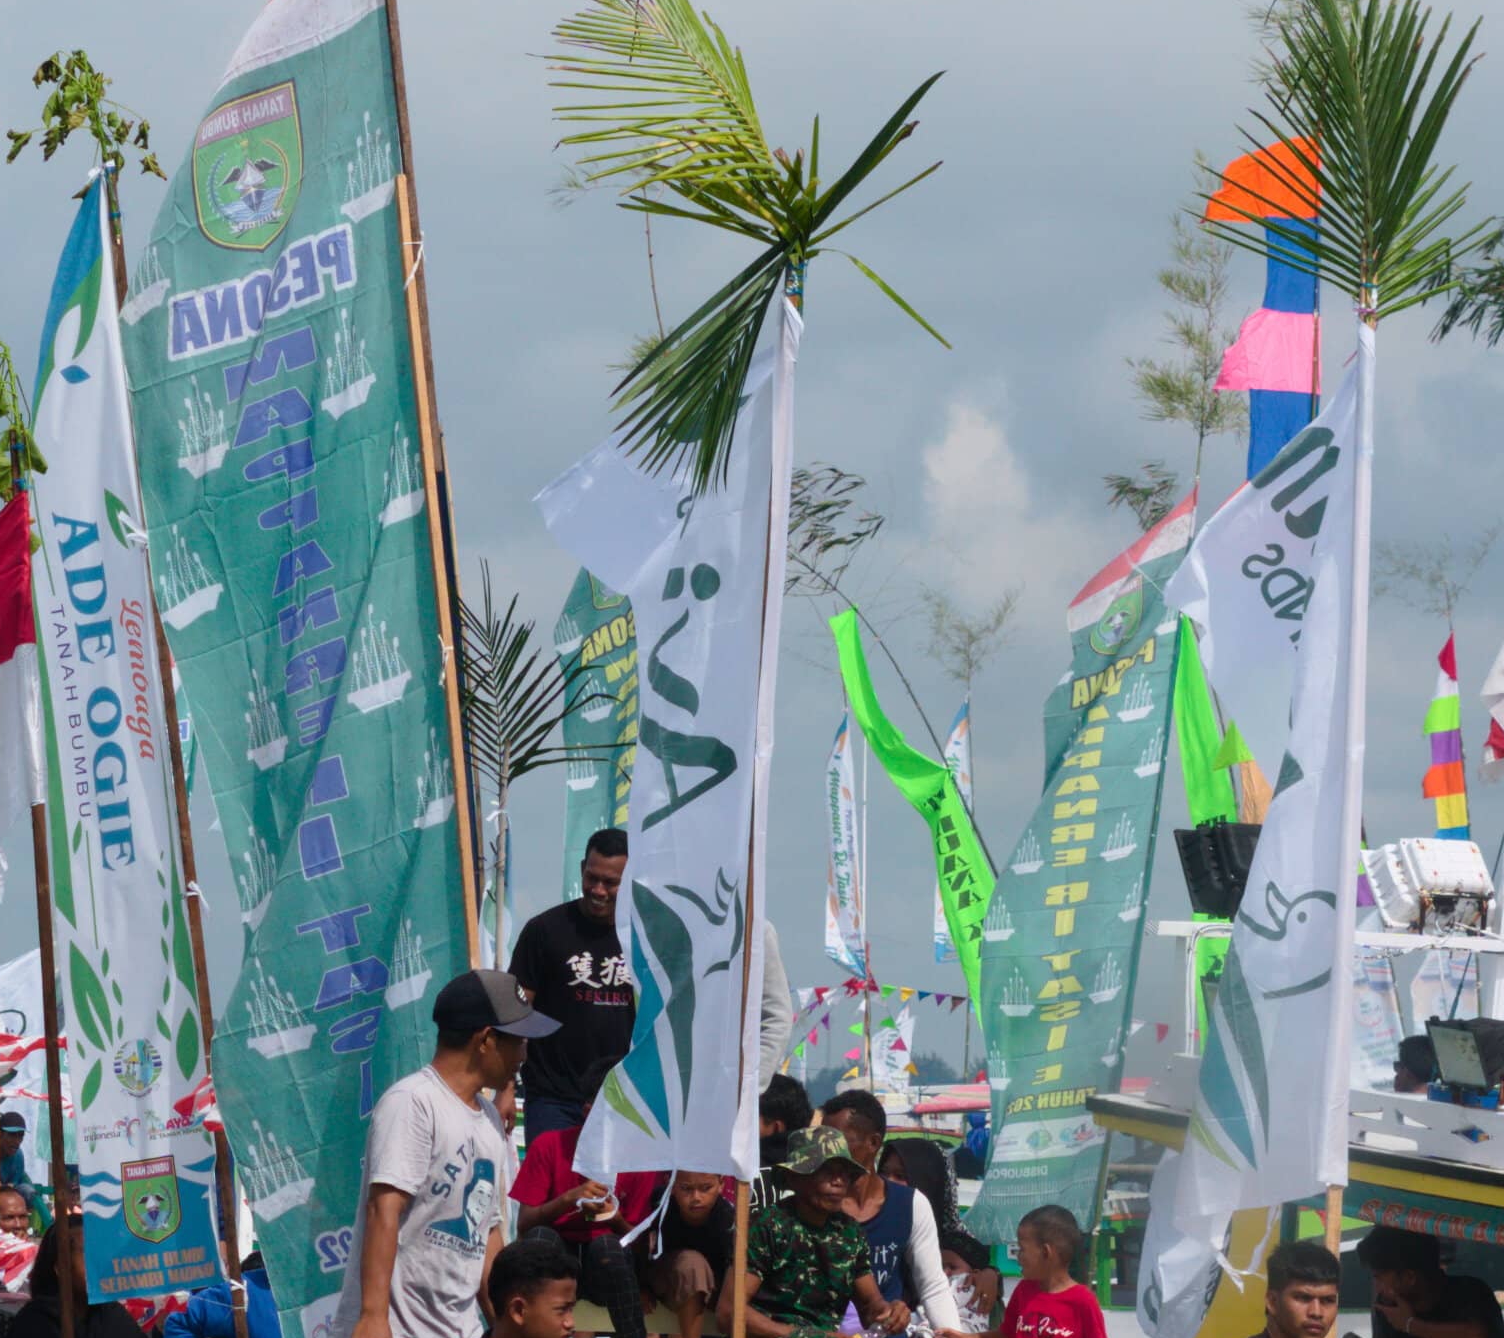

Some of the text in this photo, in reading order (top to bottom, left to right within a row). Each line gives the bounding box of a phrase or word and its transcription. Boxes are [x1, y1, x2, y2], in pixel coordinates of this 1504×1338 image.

[49, 604, 92, 820] TANAH BUMBU
[51, 511, 137, 873] ADE OGIE
[575, 990, 632, 1002] SEKIRO
